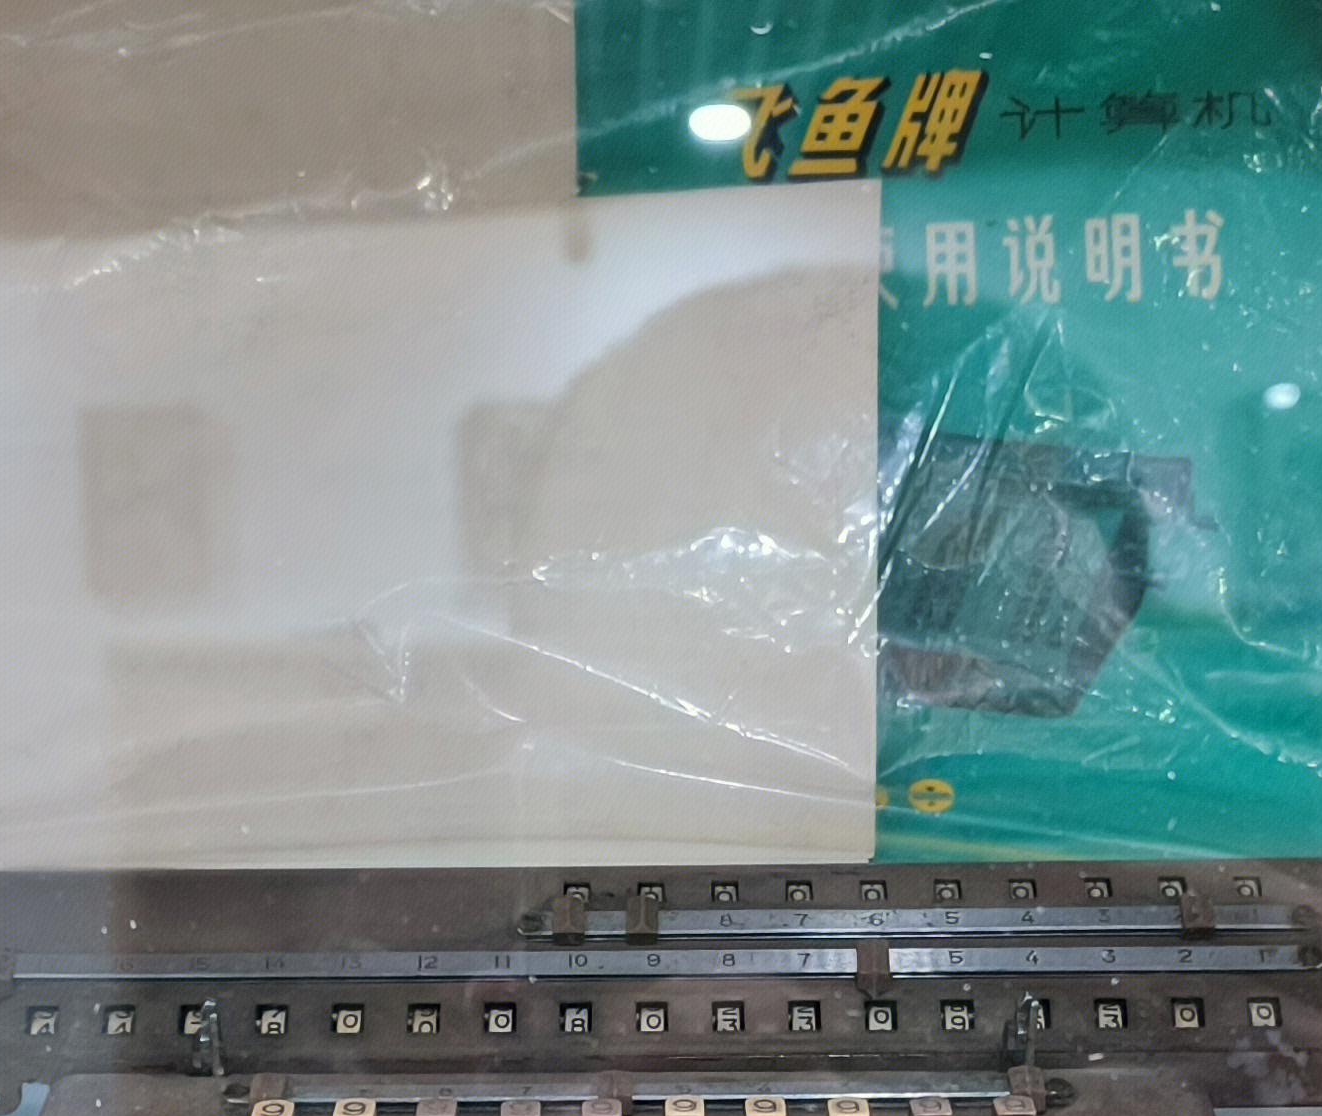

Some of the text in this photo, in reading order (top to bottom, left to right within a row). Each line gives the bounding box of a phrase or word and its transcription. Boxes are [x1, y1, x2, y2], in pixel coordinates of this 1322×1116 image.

[729, 68, 989, 182] 飞鱼牌
[793, 913, 808, 927] 7
[944, 910, 960, 925] 5
[1020, 910, 1035, 924] 4
[417, 954, 438, 971] 12
[494, 954, 511, 969] 11
[568, 953, 588, 970] 10
[646, 953, 661, 968] 9
[722, 953, 736, 967] 8
[796, 952, 811, 968] 7
[947, 950, 964, 965] 5
[1026, 949, 1039, 965] 4
[1101, 948, 1116, 964] 3
[1177, 948, 1193, 964] 2
[342, 1013, 358, 1029] 0
[494, 1013, 510, 1029] 0
[646, 1013, 662, 1030] 0
[873, 1009, 889, 1025] 0
[1179, 1006, 1196, 1023] 0
[1256, 1005, 1273, 1020] 0
[259, 1102, 285, 1116] 9
[342, 1101, 367, 1116] 9
[671, 1098, 697, 1112] 9
[753, 1098, 777, 1113] 9
[836, 1099, 860, 1114] 9
